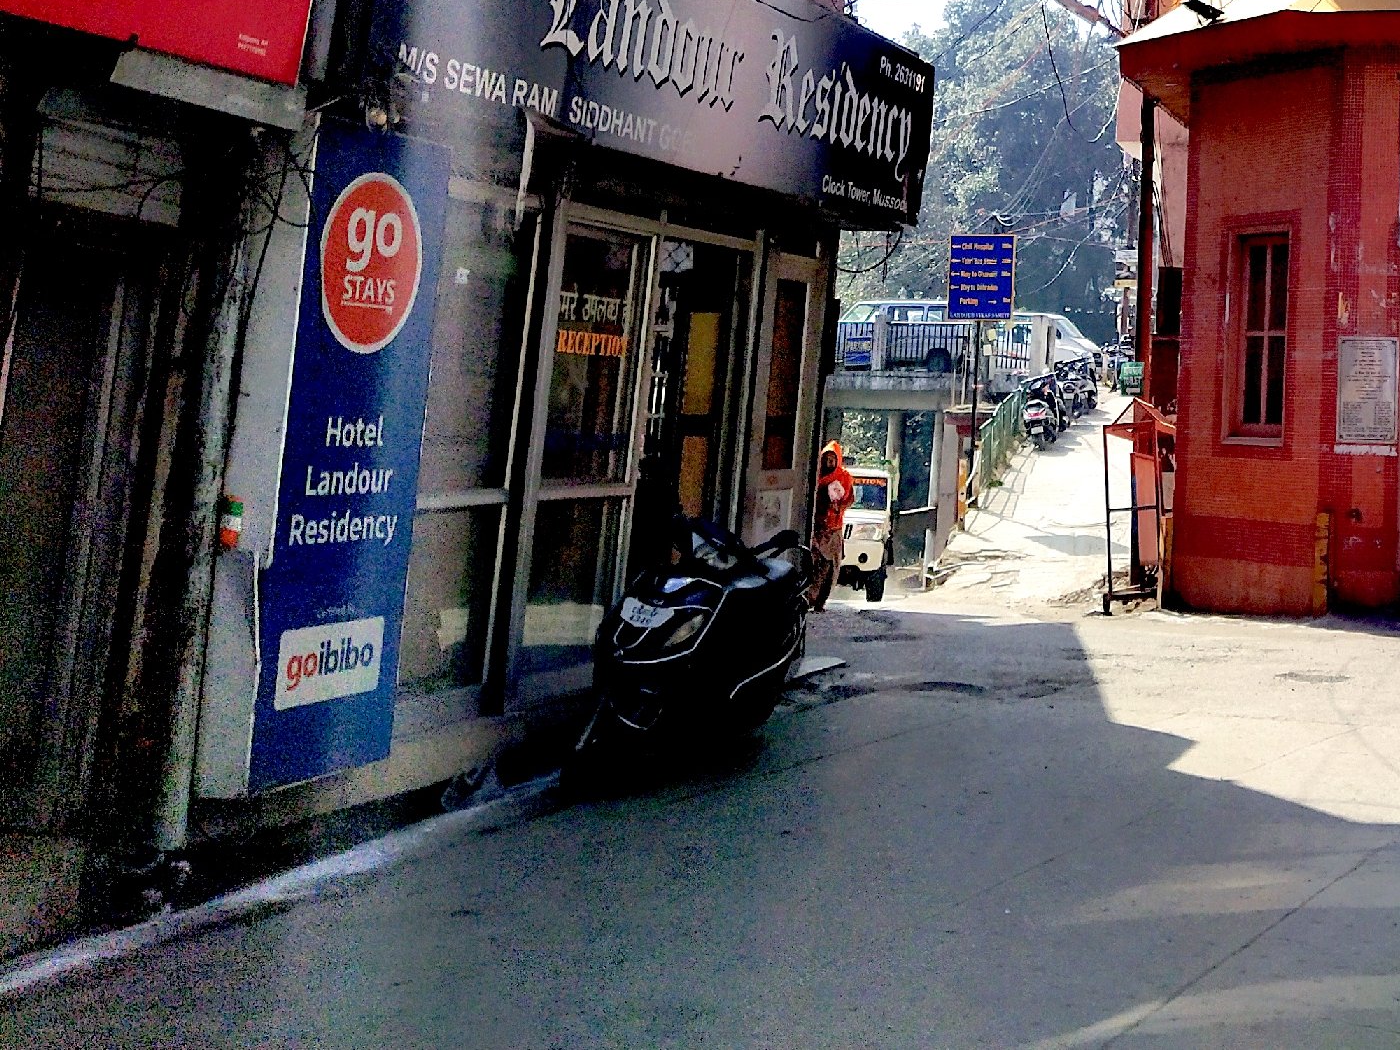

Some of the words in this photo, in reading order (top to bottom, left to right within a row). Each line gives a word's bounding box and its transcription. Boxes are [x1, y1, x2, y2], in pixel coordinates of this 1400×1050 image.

[880, 55, 893, 78] Ph.
[444, 58, 507, 105] SEWA
[512, 78, 558, 118] RAM
[568, 95, 658, 143] SIDDHANT
[758, 28, 911, 181] Residency
[822, 174, 845, 197] Clock
[848, 181, 871, 206] Tower,
[345, 207, 402, 272] go
[342, 273, 397, 304] STAYS
[557, 329, 628, 358] RECEPTION
[326, 415, 384, 447] Hotel
[306, 462, 394, 495] Landour
[289, 509, 398, 546] Residency
[286, 637, 374, 691] goibibo
